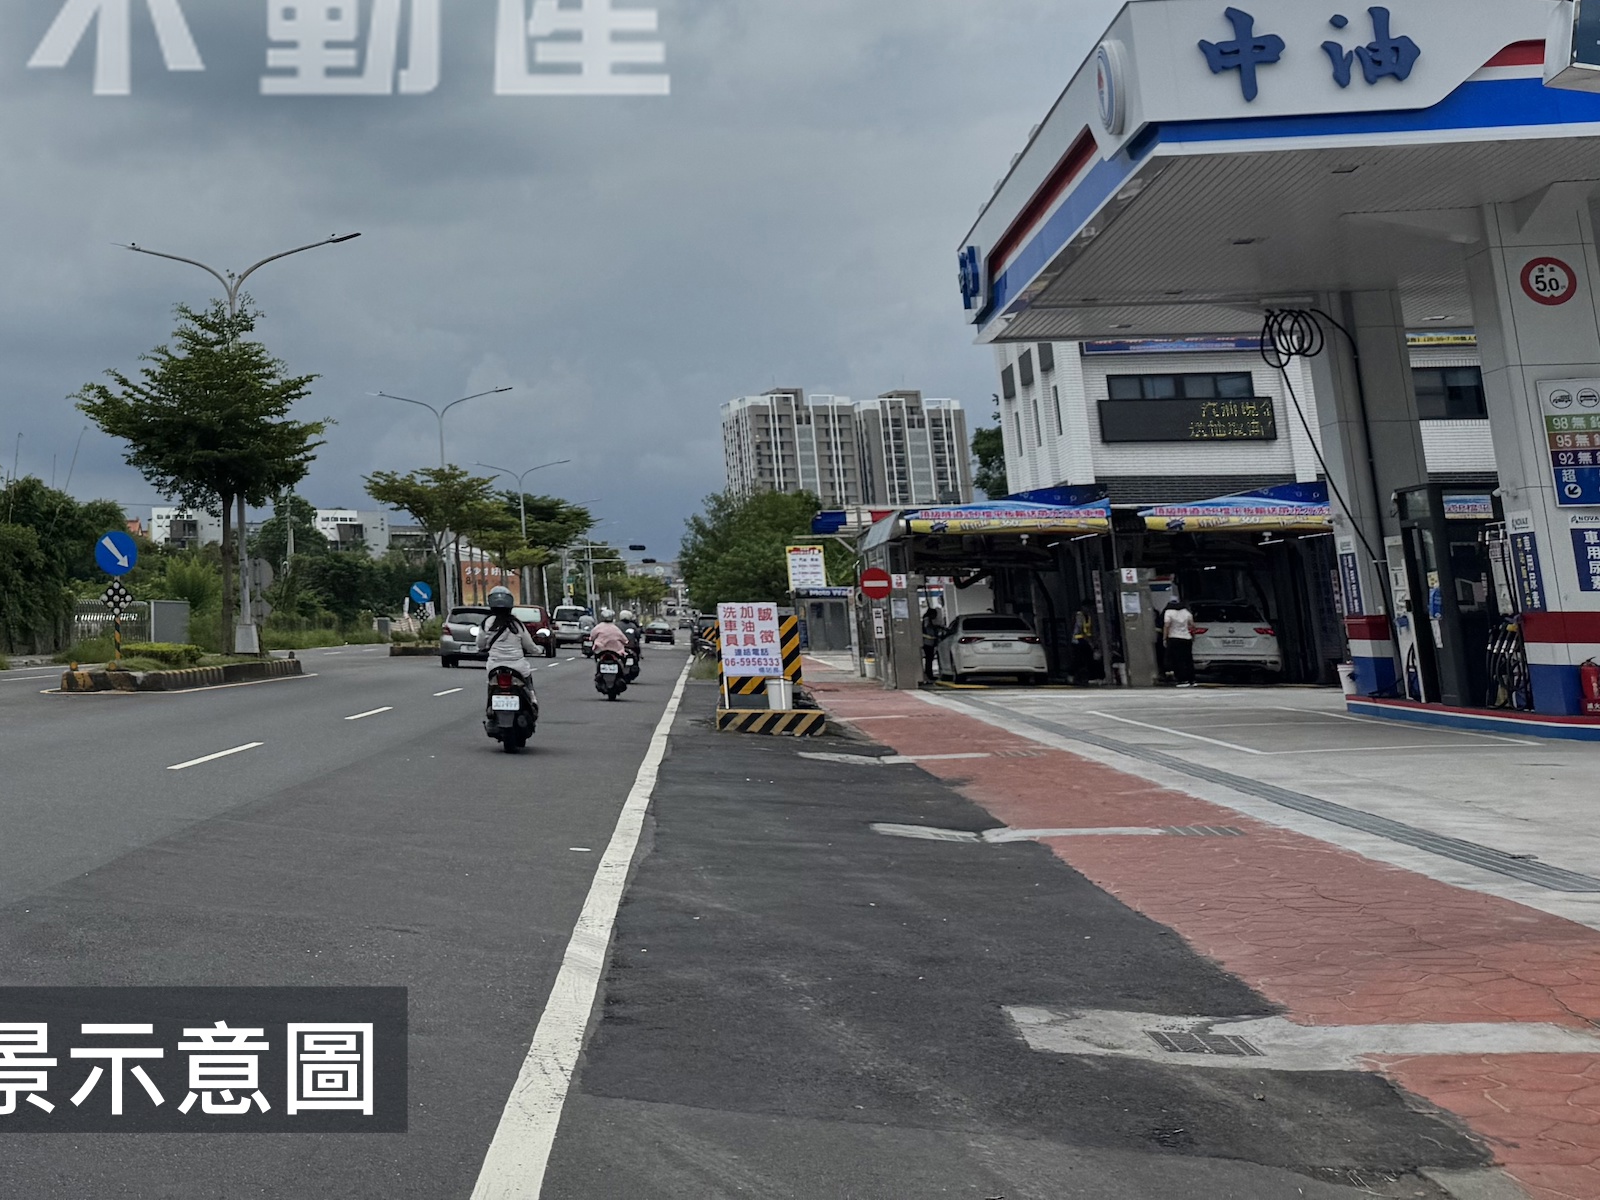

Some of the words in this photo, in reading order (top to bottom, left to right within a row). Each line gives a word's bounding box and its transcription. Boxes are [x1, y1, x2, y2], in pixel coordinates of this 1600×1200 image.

[1198, 6, 1421, 101] 中油
[1535, 274, 1560, 292] 5.0
[723, 606, 739, 646] 洗車員
[740, 605, 757, 646] 加油員
[758, 607, 775, 643] 誠徵
[874, 609, 883, 635] 出口
[724, 658, 780, 666] 06-5956333
